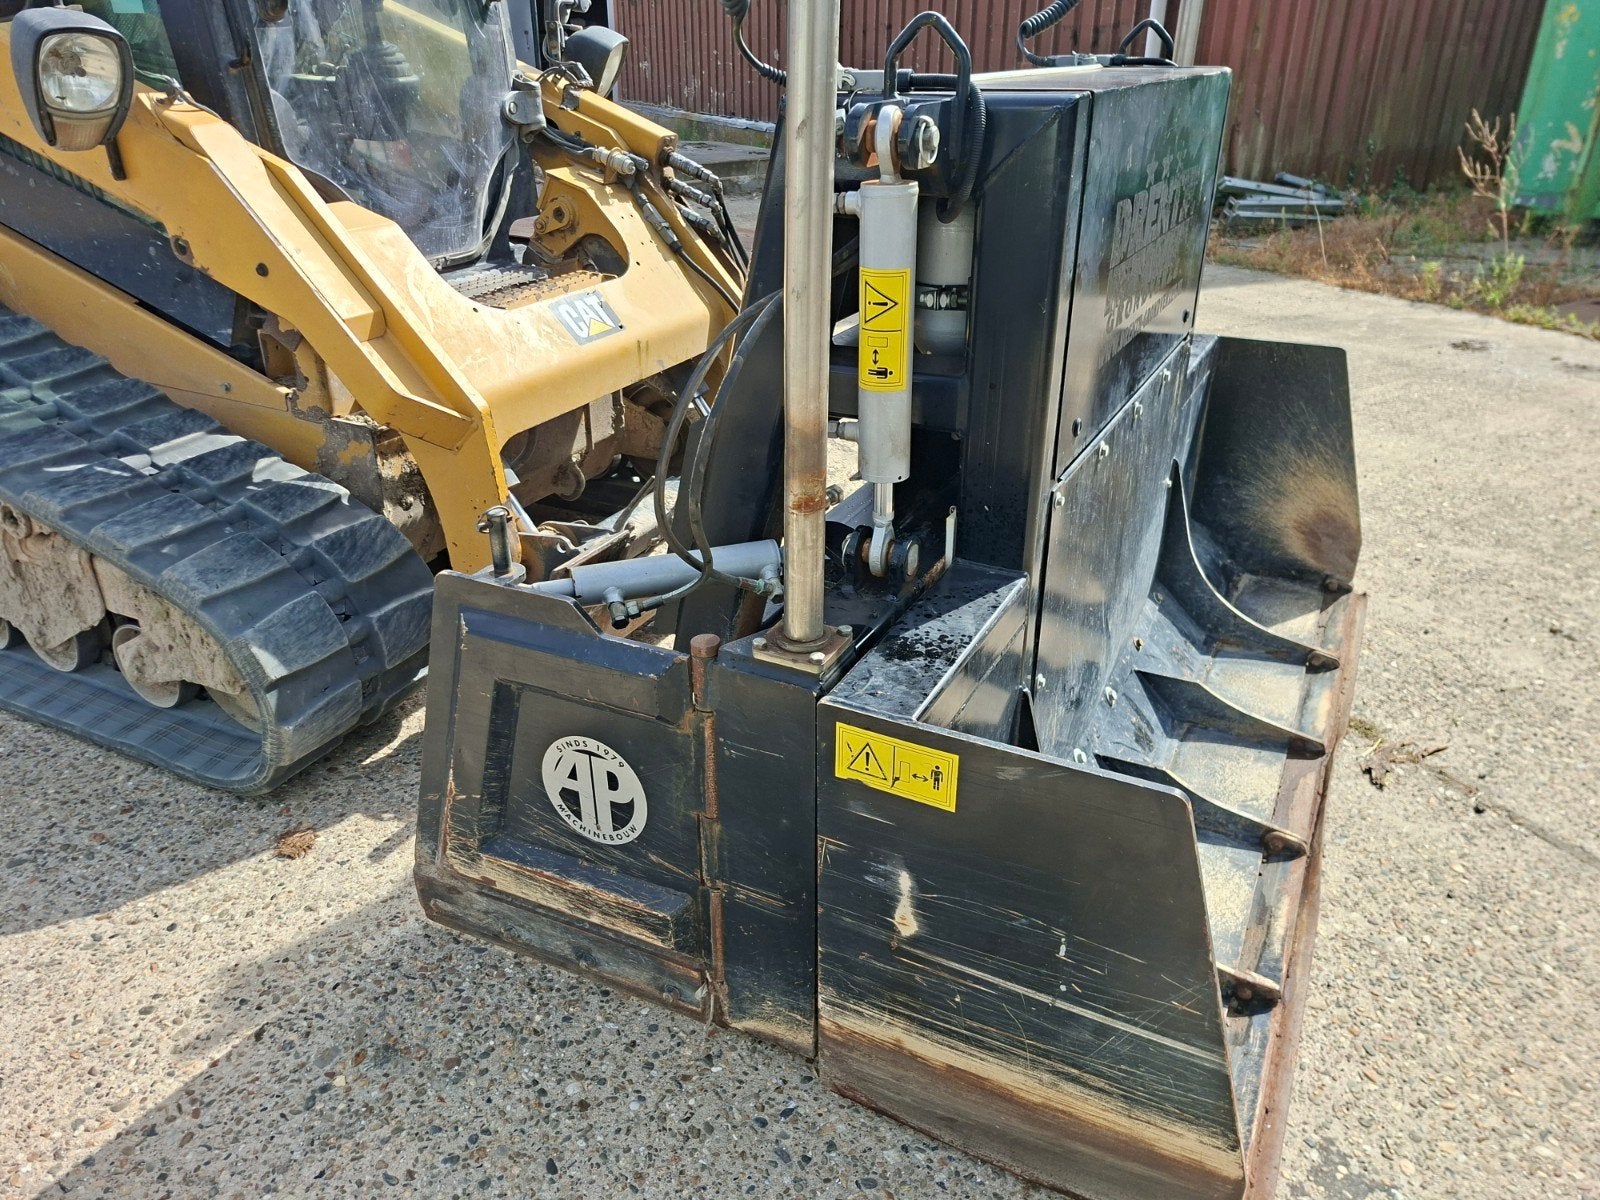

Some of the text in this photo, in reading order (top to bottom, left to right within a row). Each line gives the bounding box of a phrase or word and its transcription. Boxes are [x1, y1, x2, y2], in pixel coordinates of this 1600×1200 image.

[558, 295, 616, 338] CAT
[556, 739, 625, 768] SINDS 1979
[557, 803, 638, 841] MACHINEBOUW
